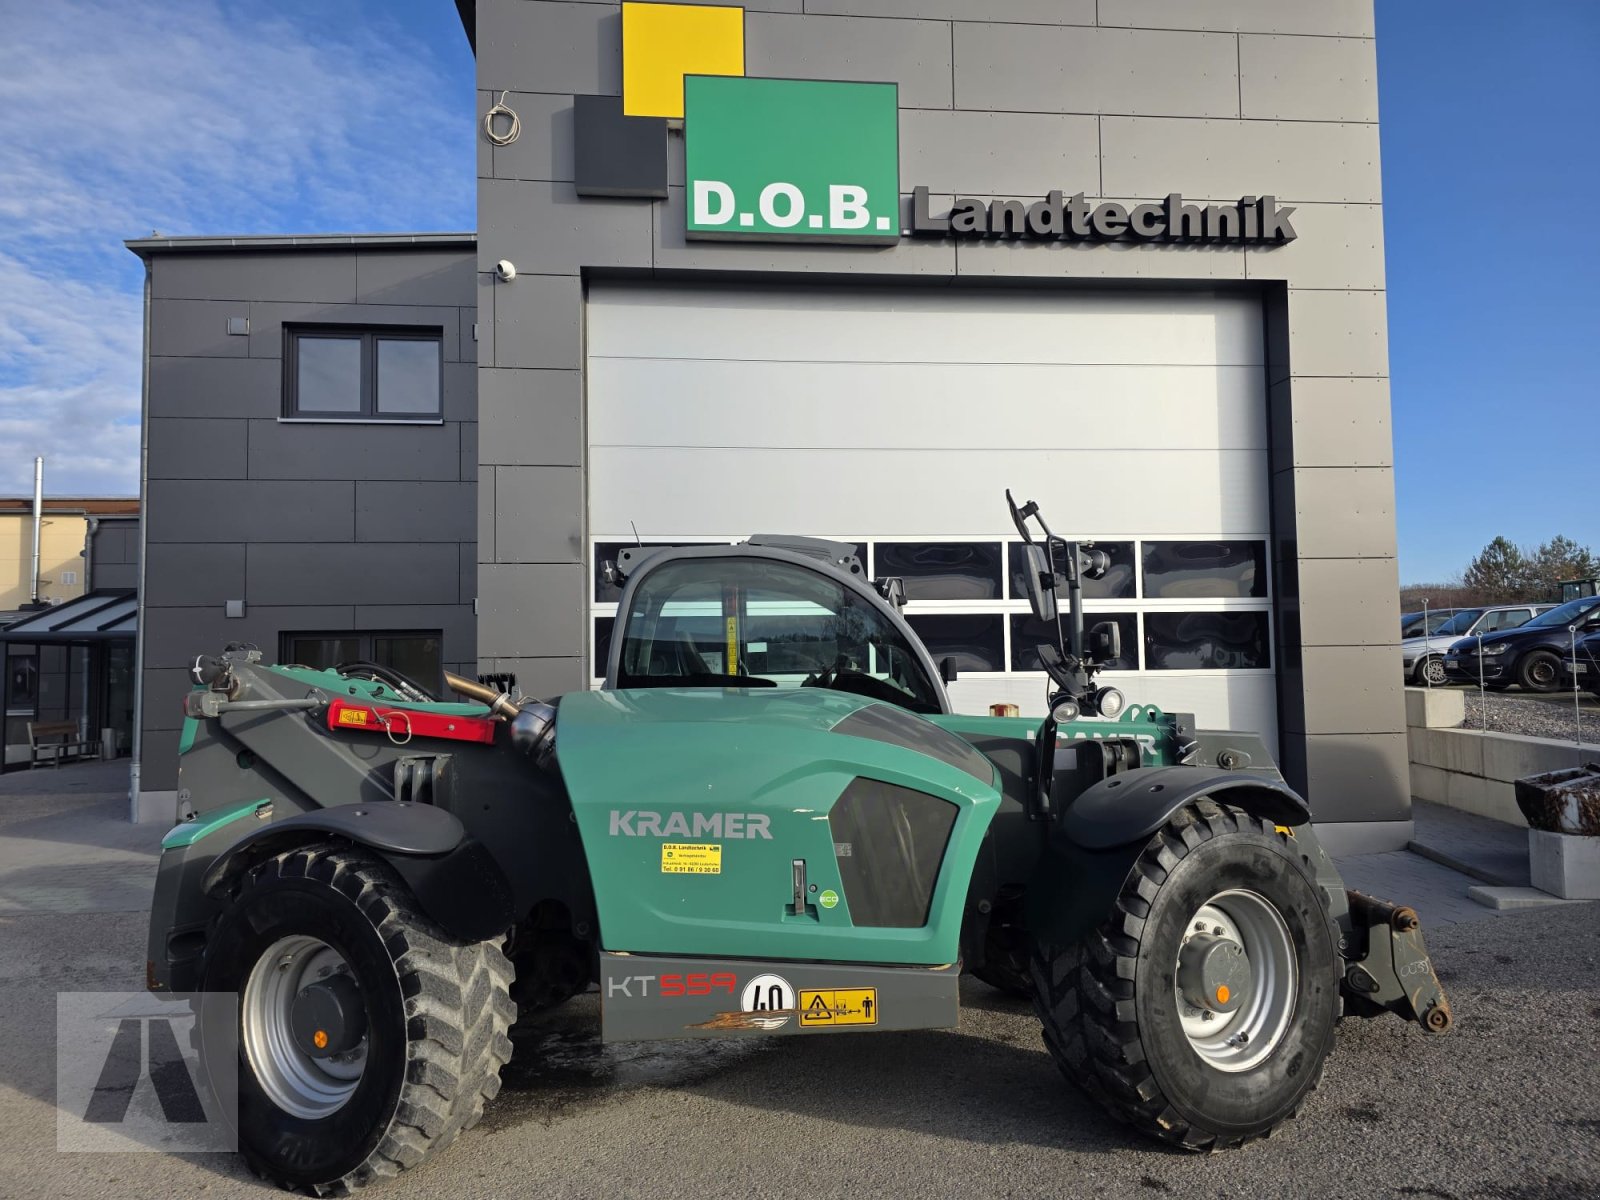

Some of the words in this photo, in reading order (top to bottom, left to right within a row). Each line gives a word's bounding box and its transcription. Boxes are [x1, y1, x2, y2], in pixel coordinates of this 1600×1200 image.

[693, 180, 891, 231] D.O.B.
[913, 186, 1298, 243] Landtechnik
[609, 810, 773, 839] KRAMER
[753, 984, 783, 1012] 40
